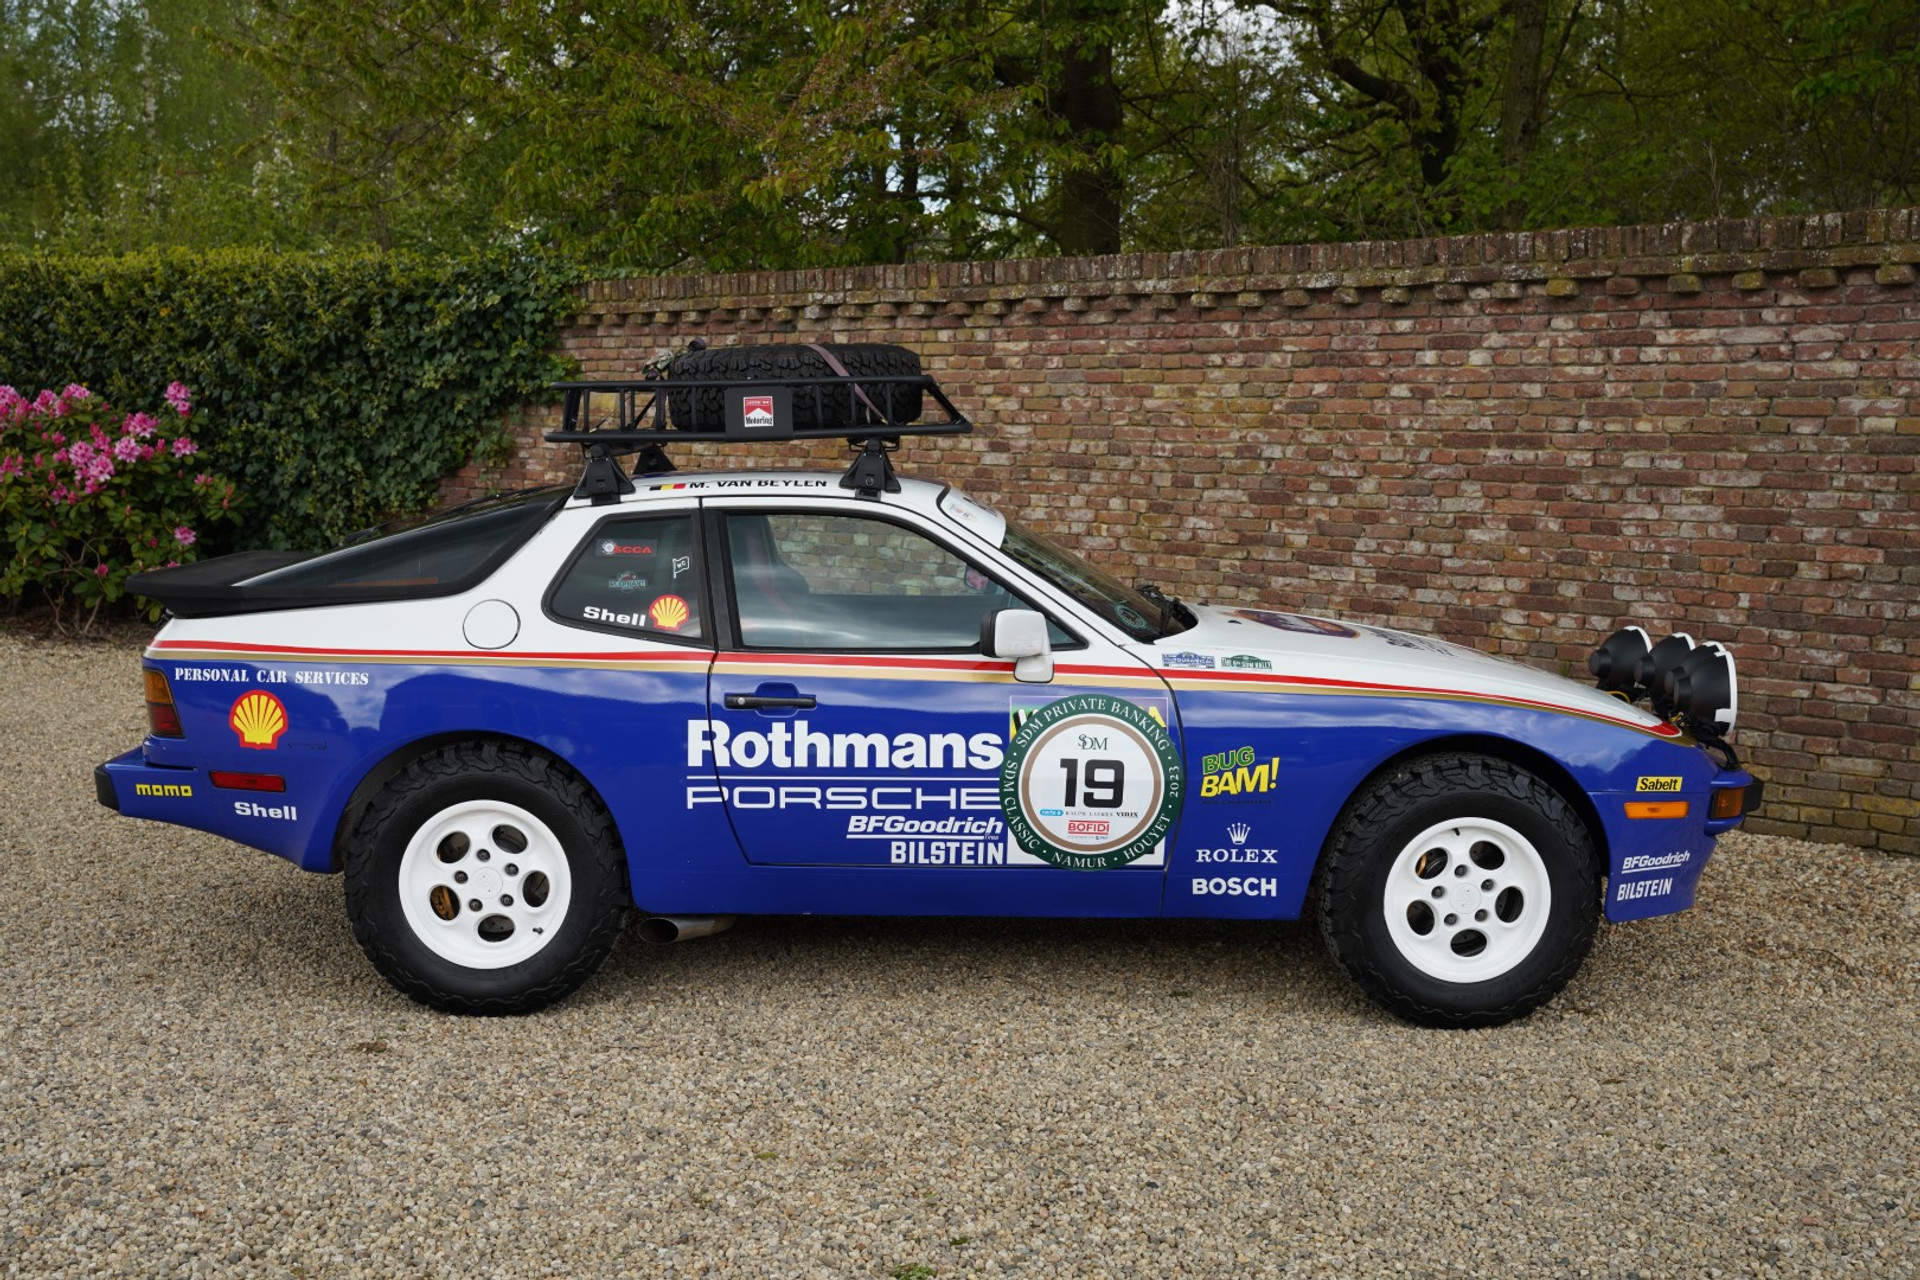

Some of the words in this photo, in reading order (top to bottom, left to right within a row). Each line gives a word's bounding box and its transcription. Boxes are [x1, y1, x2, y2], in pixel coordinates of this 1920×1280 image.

[716, 480, 752, 488] VAN
[757, 480, 827, 488] BEYLEN
[613, 546, 652, 554] SCCA
[583, 605, 646, 627] Shell
[174, 667, 249, 683] PERSONAL
[256, 669, 288, 684] CAR
[294, 671, 369, 685] SERVICES
[1016, 717, 1044, 748] SDM
[1044, 698, 1106, 722] PRIVATE
[1111, 701, 1169, 751] BANKING
[687, 719, 1004, 770] Rothmans
[1078, 734, 1109, 750] SDM
[1202, 746, 1255, 775] BUG
[1003, 760, 1018, 792] SDM
[1060, 758, 1125, 808] 19
[1169, 766, 1180, 798] 2023
[1200, 757, 1280, 797] BAM!
[1640, 778, 1678, 791] Sabelt
[686, 787, 1000, 810] PORSCHE
[234, 802, 297, 821] Shell
[1003, 796, 1040, 849] CLASSIC
[847, 815, 1003, 834] BFGoodrich
[1068, 822, 1109, 832] BOFIDI
[1123, 813, 1171, 860] HOUYET
[891, 841, 1004, 864] BILSTEIN
[1051, 852, 1107, 868] NAMUR
[1196, 849, 1278, 864] ROLEX
[1622, 850, 1690, 870] BFGoodrich
[1192, 877, 1277, 897] BOSCH
[1617, 878, 1673, 901] BILSTEIN
